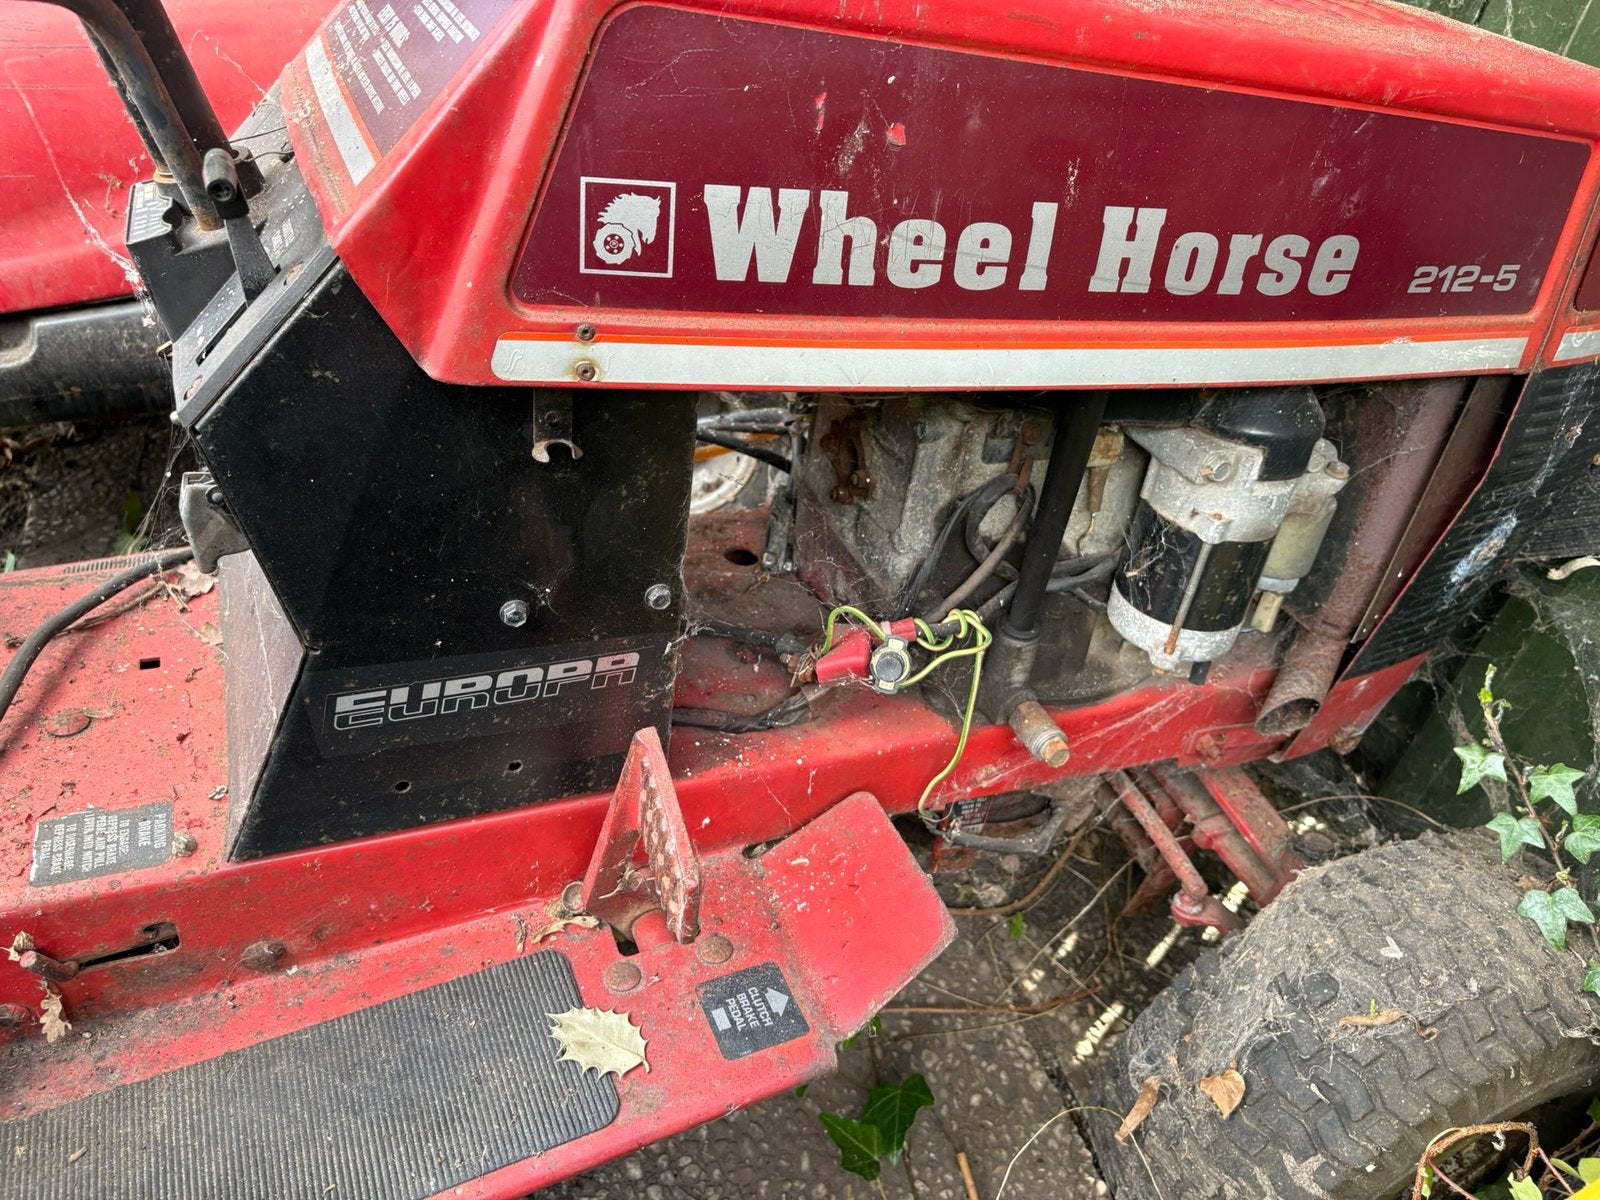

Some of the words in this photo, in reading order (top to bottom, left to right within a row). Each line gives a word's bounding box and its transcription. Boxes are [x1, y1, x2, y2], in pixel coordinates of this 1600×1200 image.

[704, 184, 1058, 290] Wheel
[1088, 206, 1360, 296] Horse
[1407, 264, 1521, 294] 212-5
[334, 652, 640, 730] EUROPA
[120, 819, 130, 827] TO
[138, 821, 151, 847] BRAKE
[154, 813, 166, 848] PARKING
[106, 843, 117, 865] BRAKE
[726, 998, 746, 1032] PEDAL
[737, 993, 760, 1028] BRAKE
[748, 987, 773, 1027] CLUTCH
